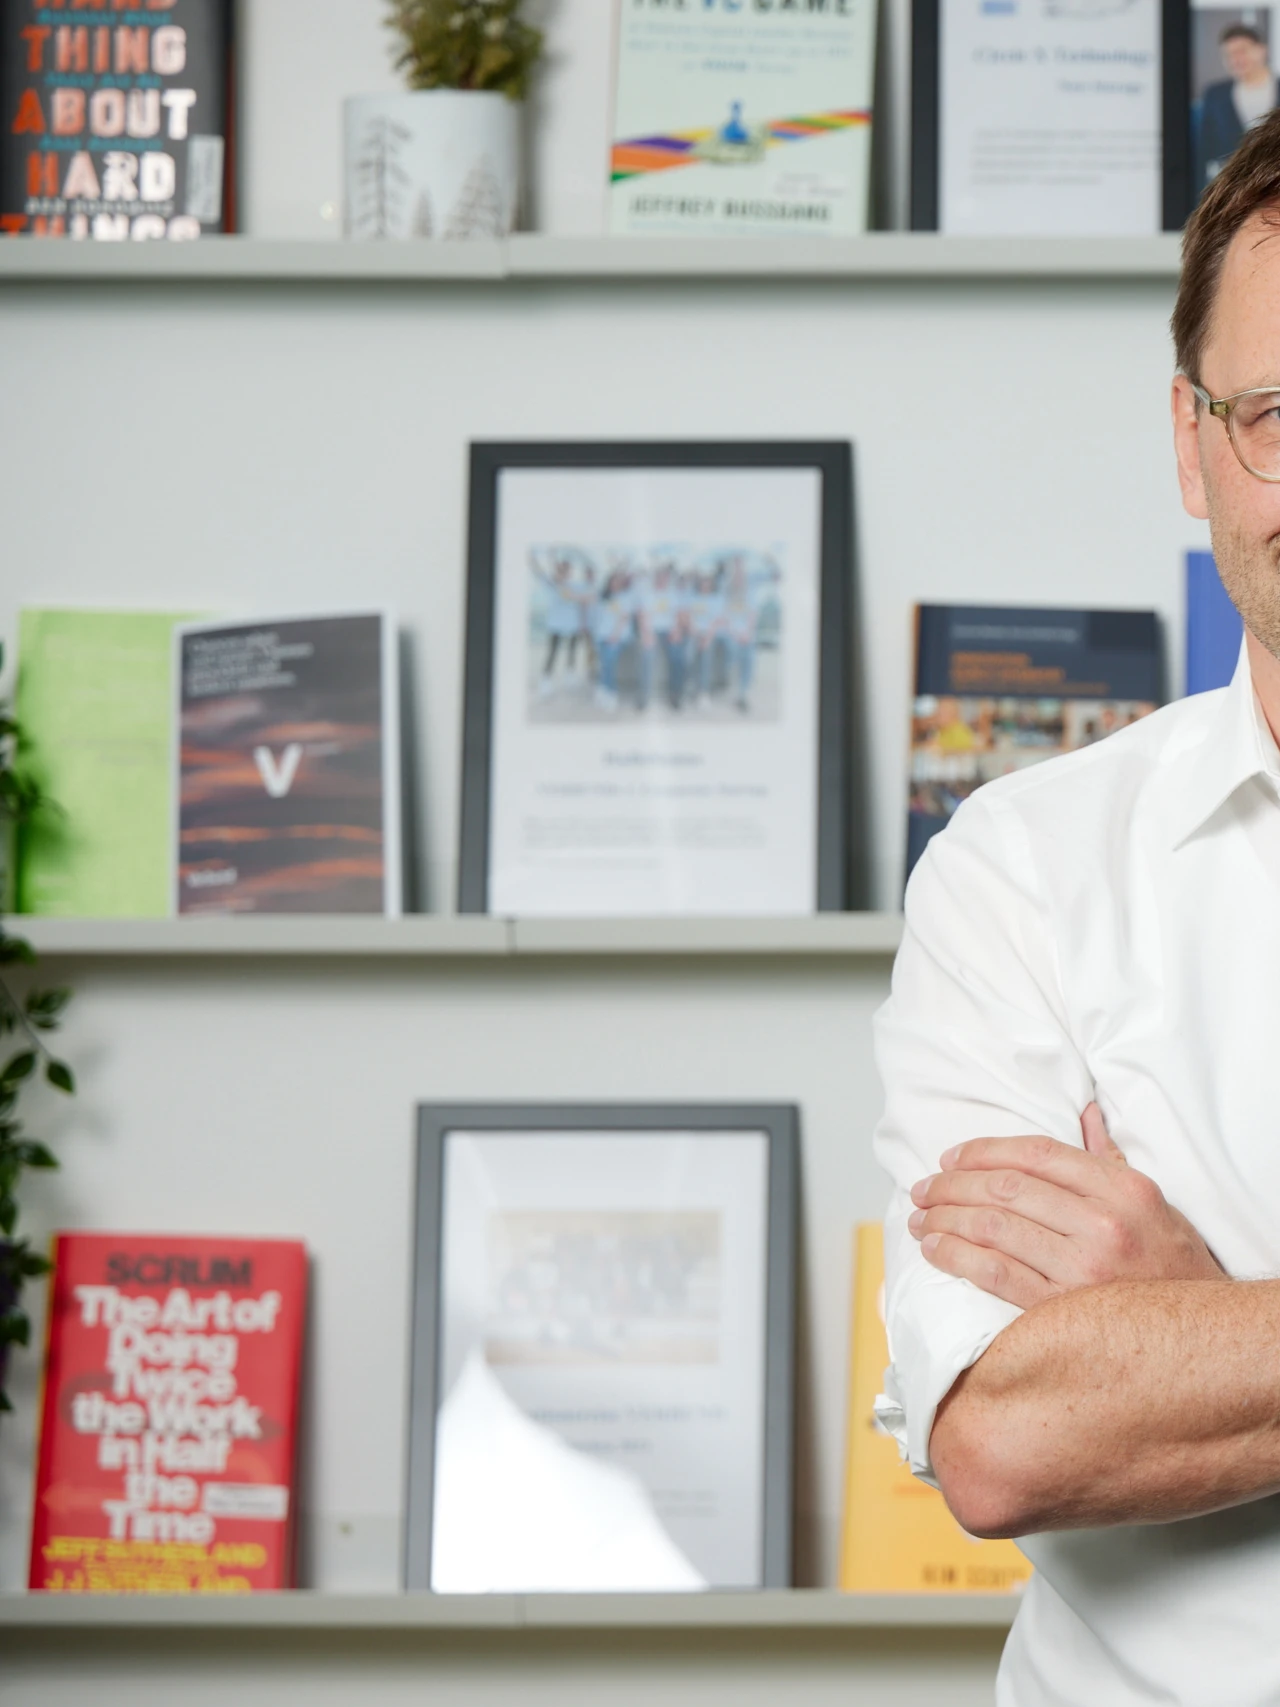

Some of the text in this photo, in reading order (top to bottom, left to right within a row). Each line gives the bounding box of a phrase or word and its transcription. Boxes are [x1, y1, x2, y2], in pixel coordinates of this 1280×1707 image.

[20, 25, 187, 75] THING
[11, 88, 197, 140] ABOUT
[26, 151, 176, 201] HARD
[253, 743, 303, 798] V
[106, 1253, 254, 1287] SCRUM
[75, 1285, 281, 1332] The Art of
[108, 1325, 238, 1372] Doing
[109, 1362, 236, 1401] Twice
[72, 1390, 262, 1440] the Work
[98, 1430, 232, 1473] in Half
[125, 1461, 199, 1507] the
[103, 1499, 216, 1544] Time
